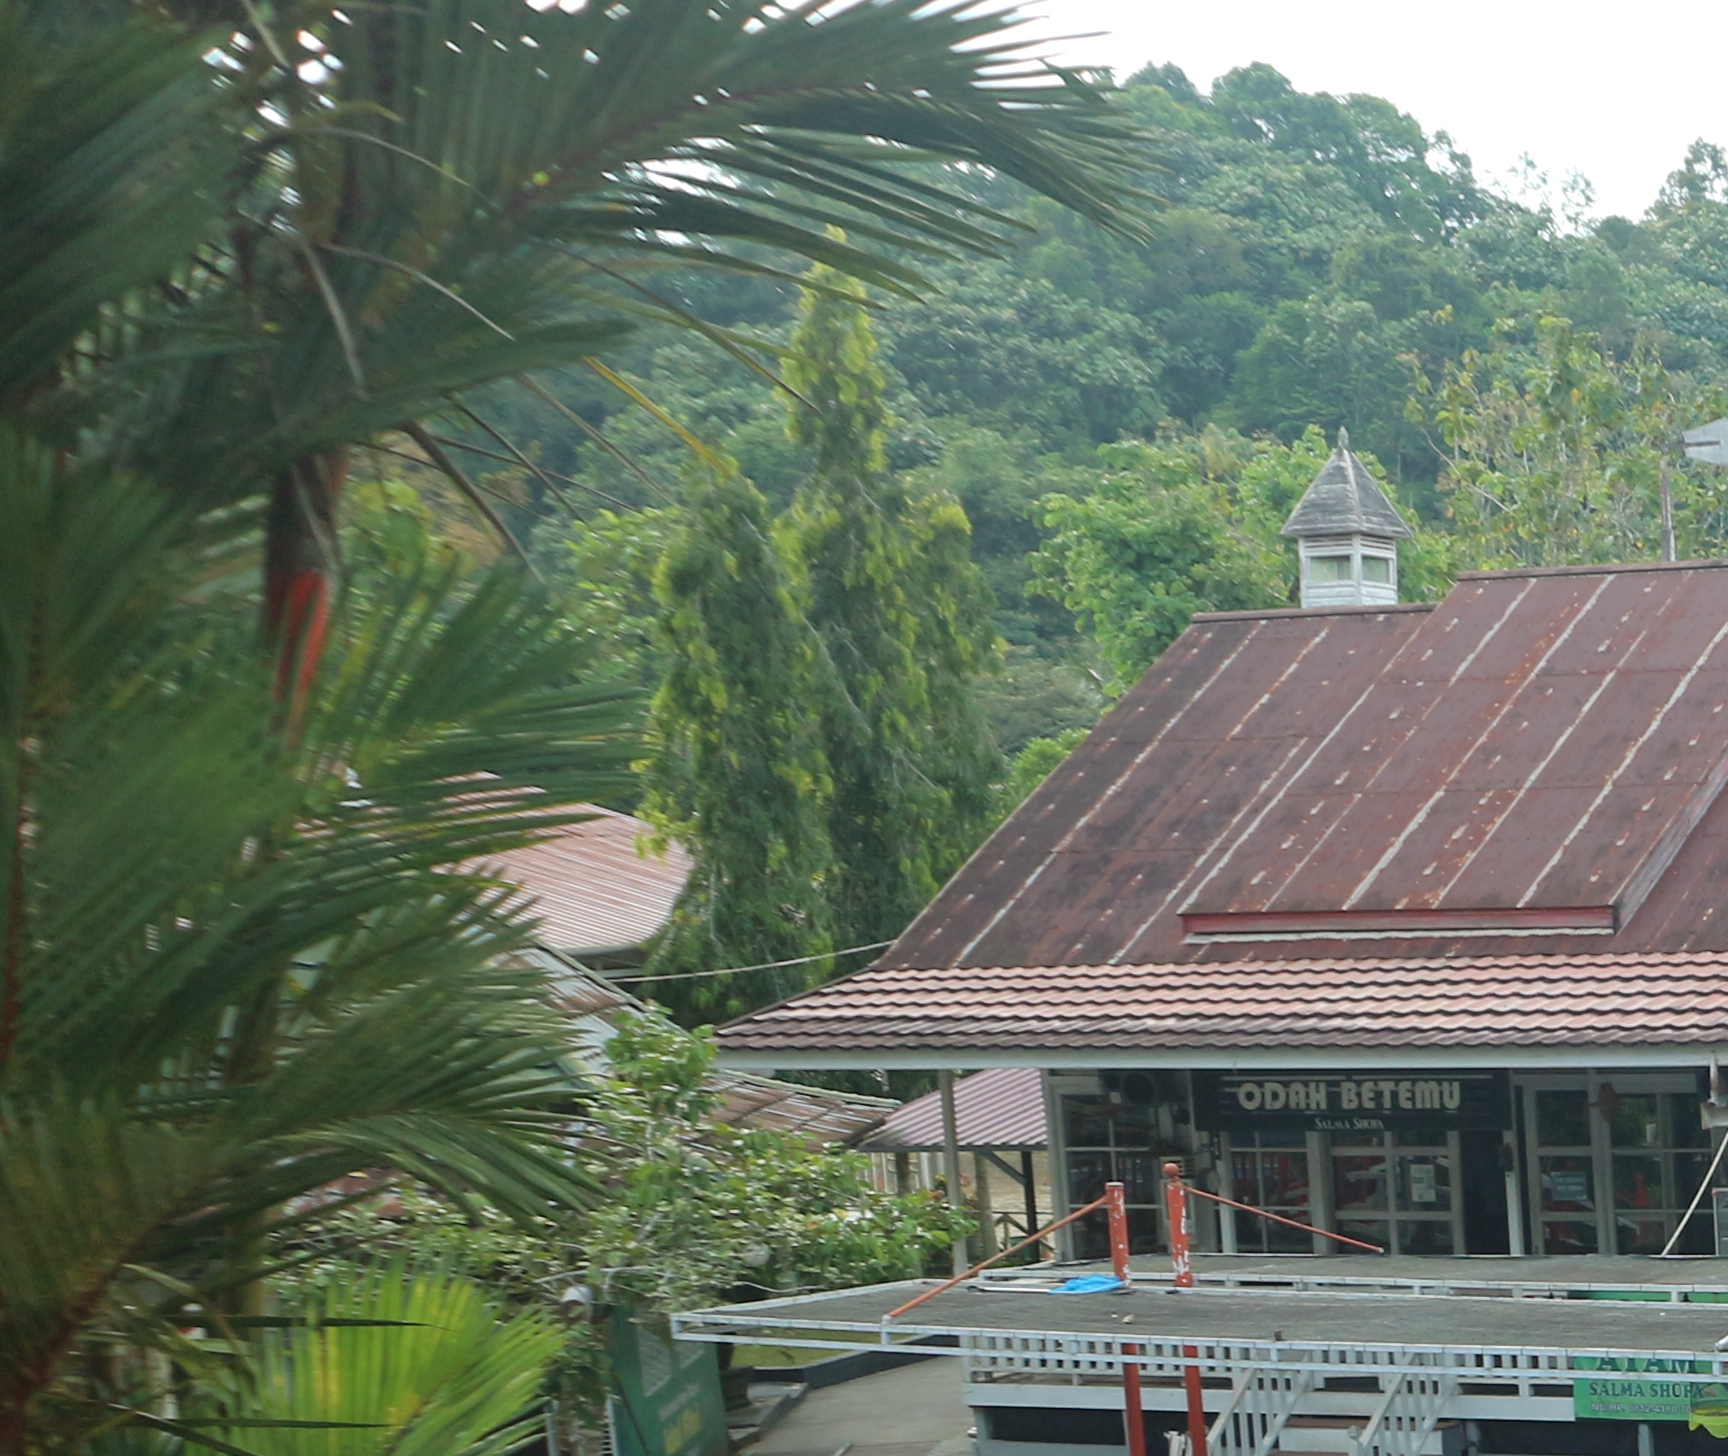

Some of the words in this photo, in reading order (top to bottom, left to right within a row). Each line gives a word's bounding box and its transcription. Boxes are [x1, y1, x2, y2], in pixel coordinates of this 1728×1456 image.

[1237, 1081, 1327, 1110] ODAH
[1340, 1081, 1461, 1110] BETEMU
[1589, 1382, 1645, 1398] SALMA
